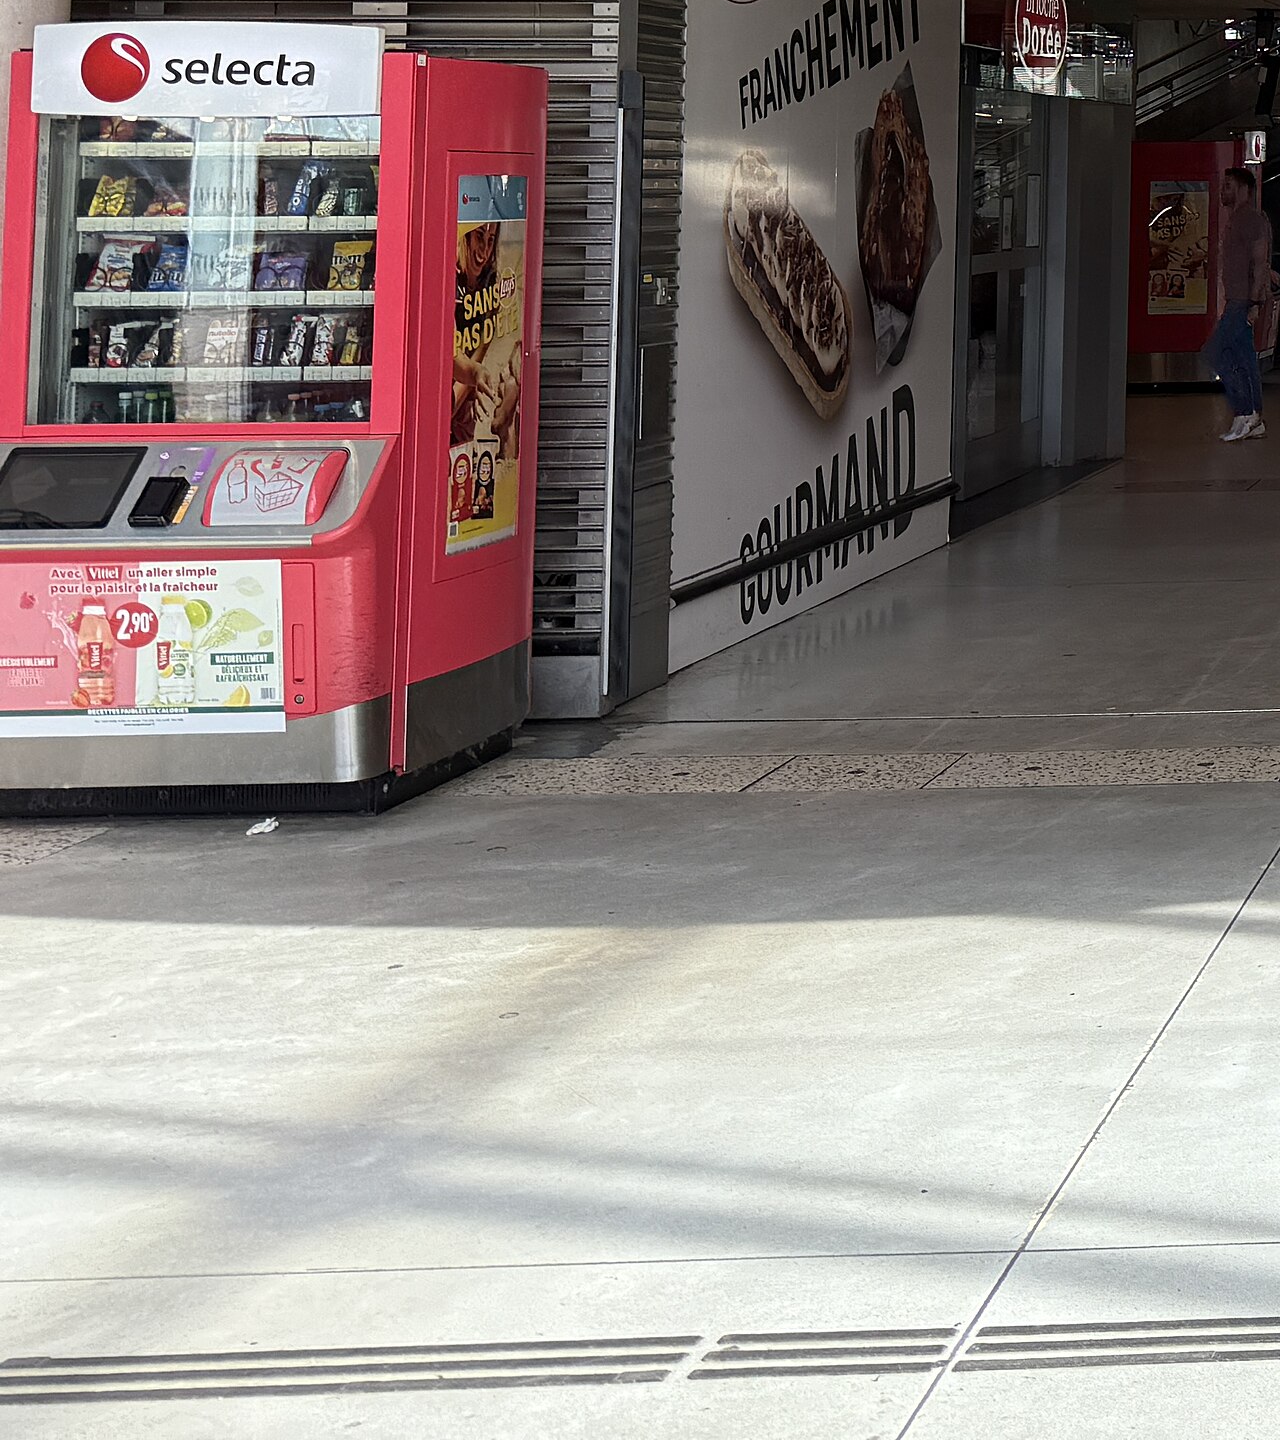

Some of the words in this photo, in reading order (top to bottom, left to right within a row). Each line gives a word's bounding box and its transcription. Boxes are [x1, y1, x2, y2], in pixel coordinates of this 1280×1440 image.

[1022, 17, 1062, 58] Dorée
[162, 52, 315, 87] selecta
[463, 283, 500, 321] SANS
[453, 322, 482, 358] PAS
[739, 383, 916, 624] GOURMAND
[51, 568, 81, 579] Avec
[88, 567, 120, 580] Vittel
[128, 569, 144, 578] un
[146, 567, 173, 578] aller
[175, 567, 217, 580] simple
[51, 584, 78, 595] pour
[81, 583, 92, 593] le
[94, 582, 134, 595] plaisir
[136, 582, 149, 593] et
[150, 582, 161, 593] la
[162, 581, 218, 593] fraîcheur
